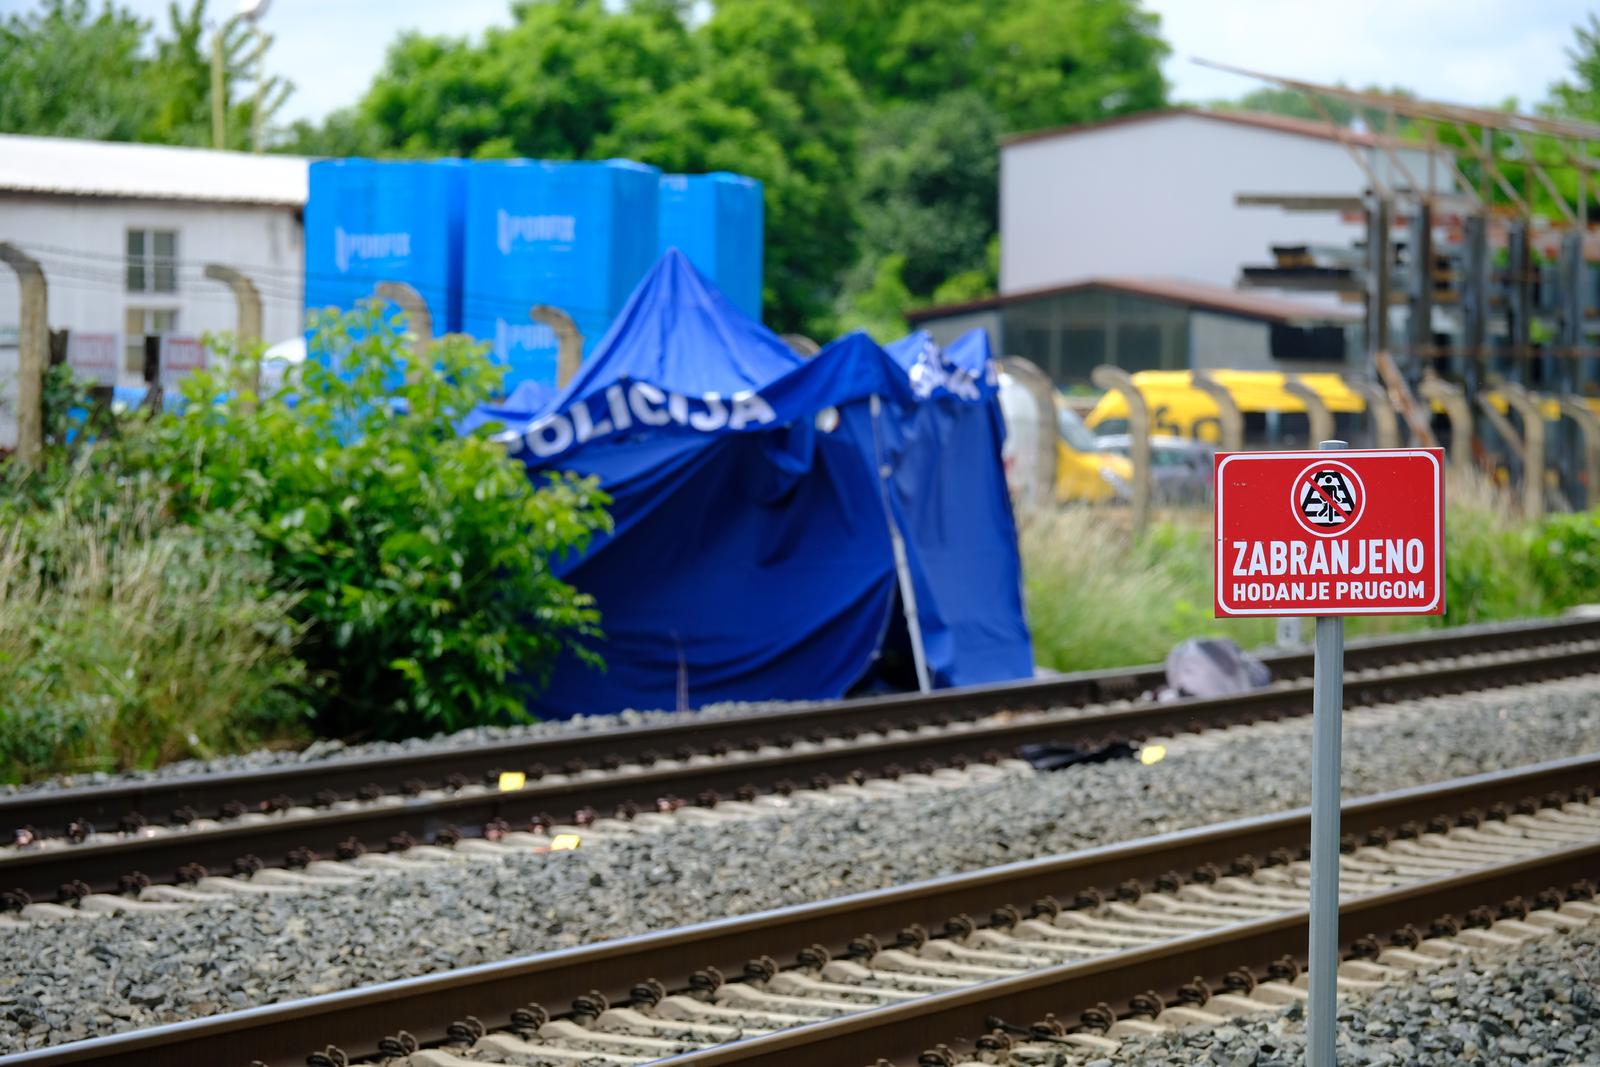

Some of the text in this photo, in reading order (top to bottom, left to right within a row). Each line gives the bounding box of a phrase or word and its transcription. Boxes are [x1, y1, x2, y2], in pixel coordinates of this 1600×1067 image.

[1232, 538, 1425, 577] ZABRANJENO
[1232, 580, 1425, 602] HODANJE PRUGOM
